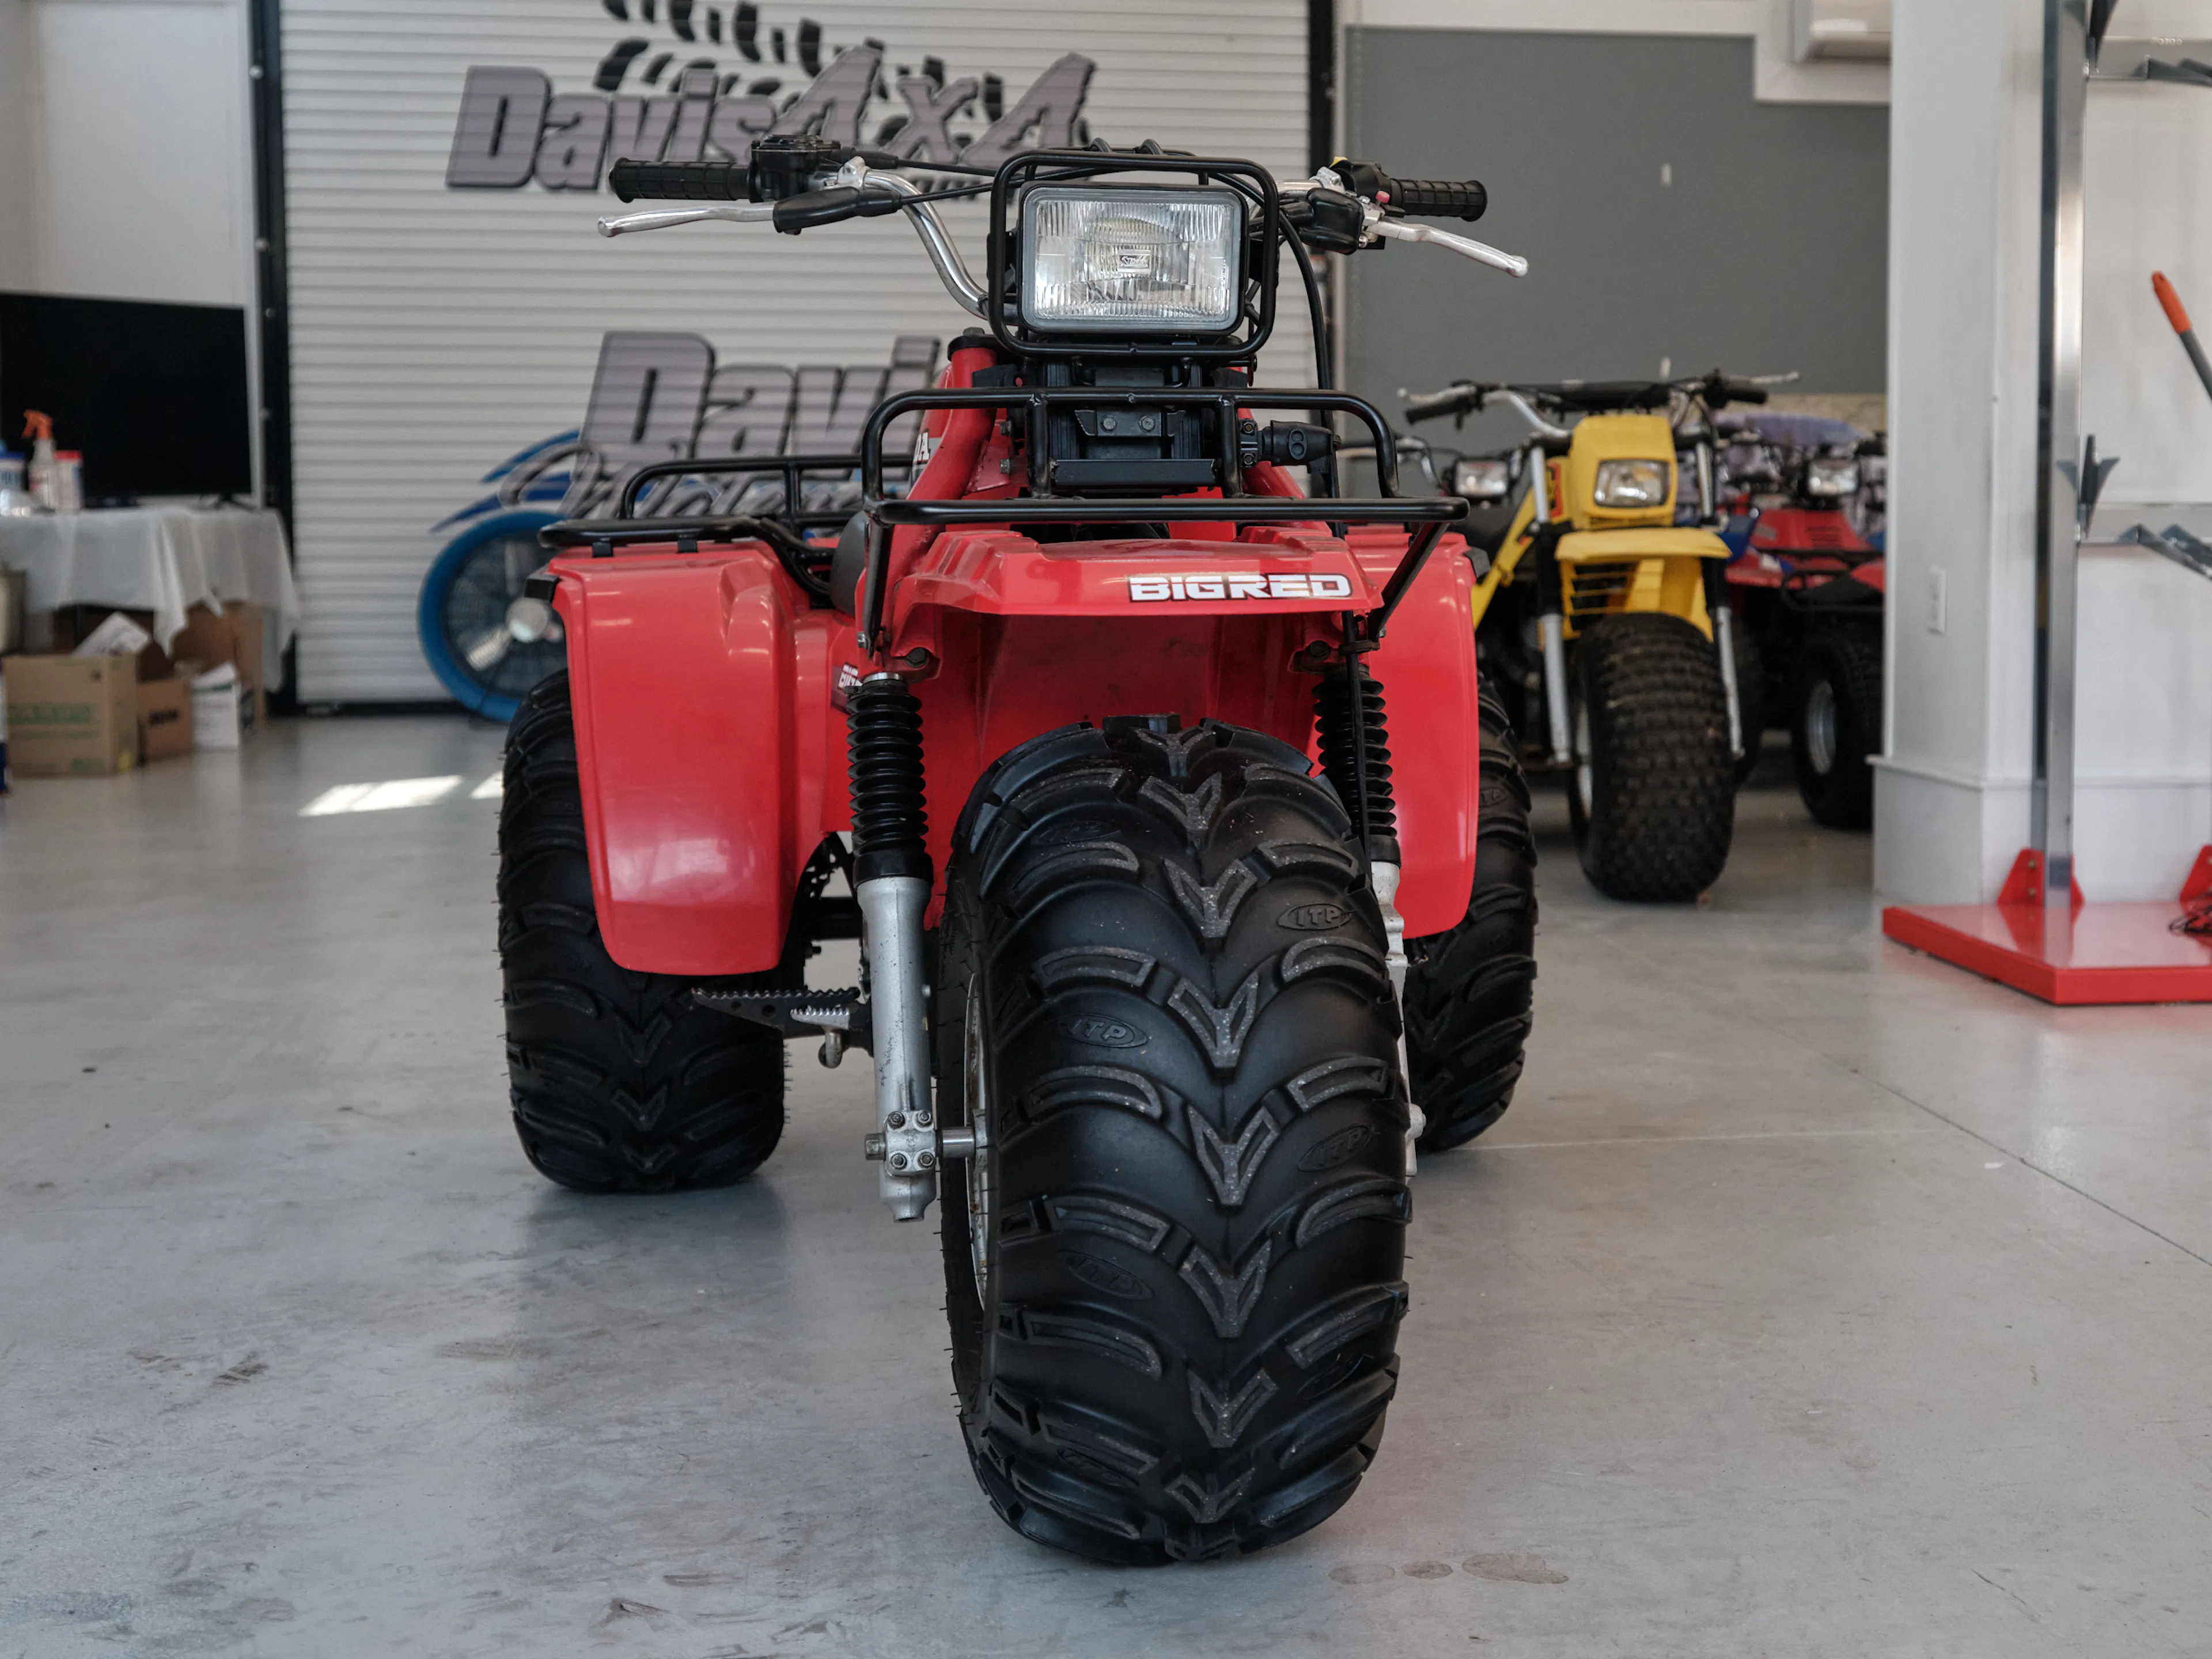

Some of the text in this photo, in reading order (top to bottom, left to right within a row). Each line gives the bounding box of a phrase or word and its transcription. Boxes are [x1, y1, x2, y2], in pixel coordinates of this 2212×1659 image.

[572, 330, 940, 481] Davi
[1296, 907, 1340, 927] ITP
[1071, 1018, 1127, 1041] ITP
